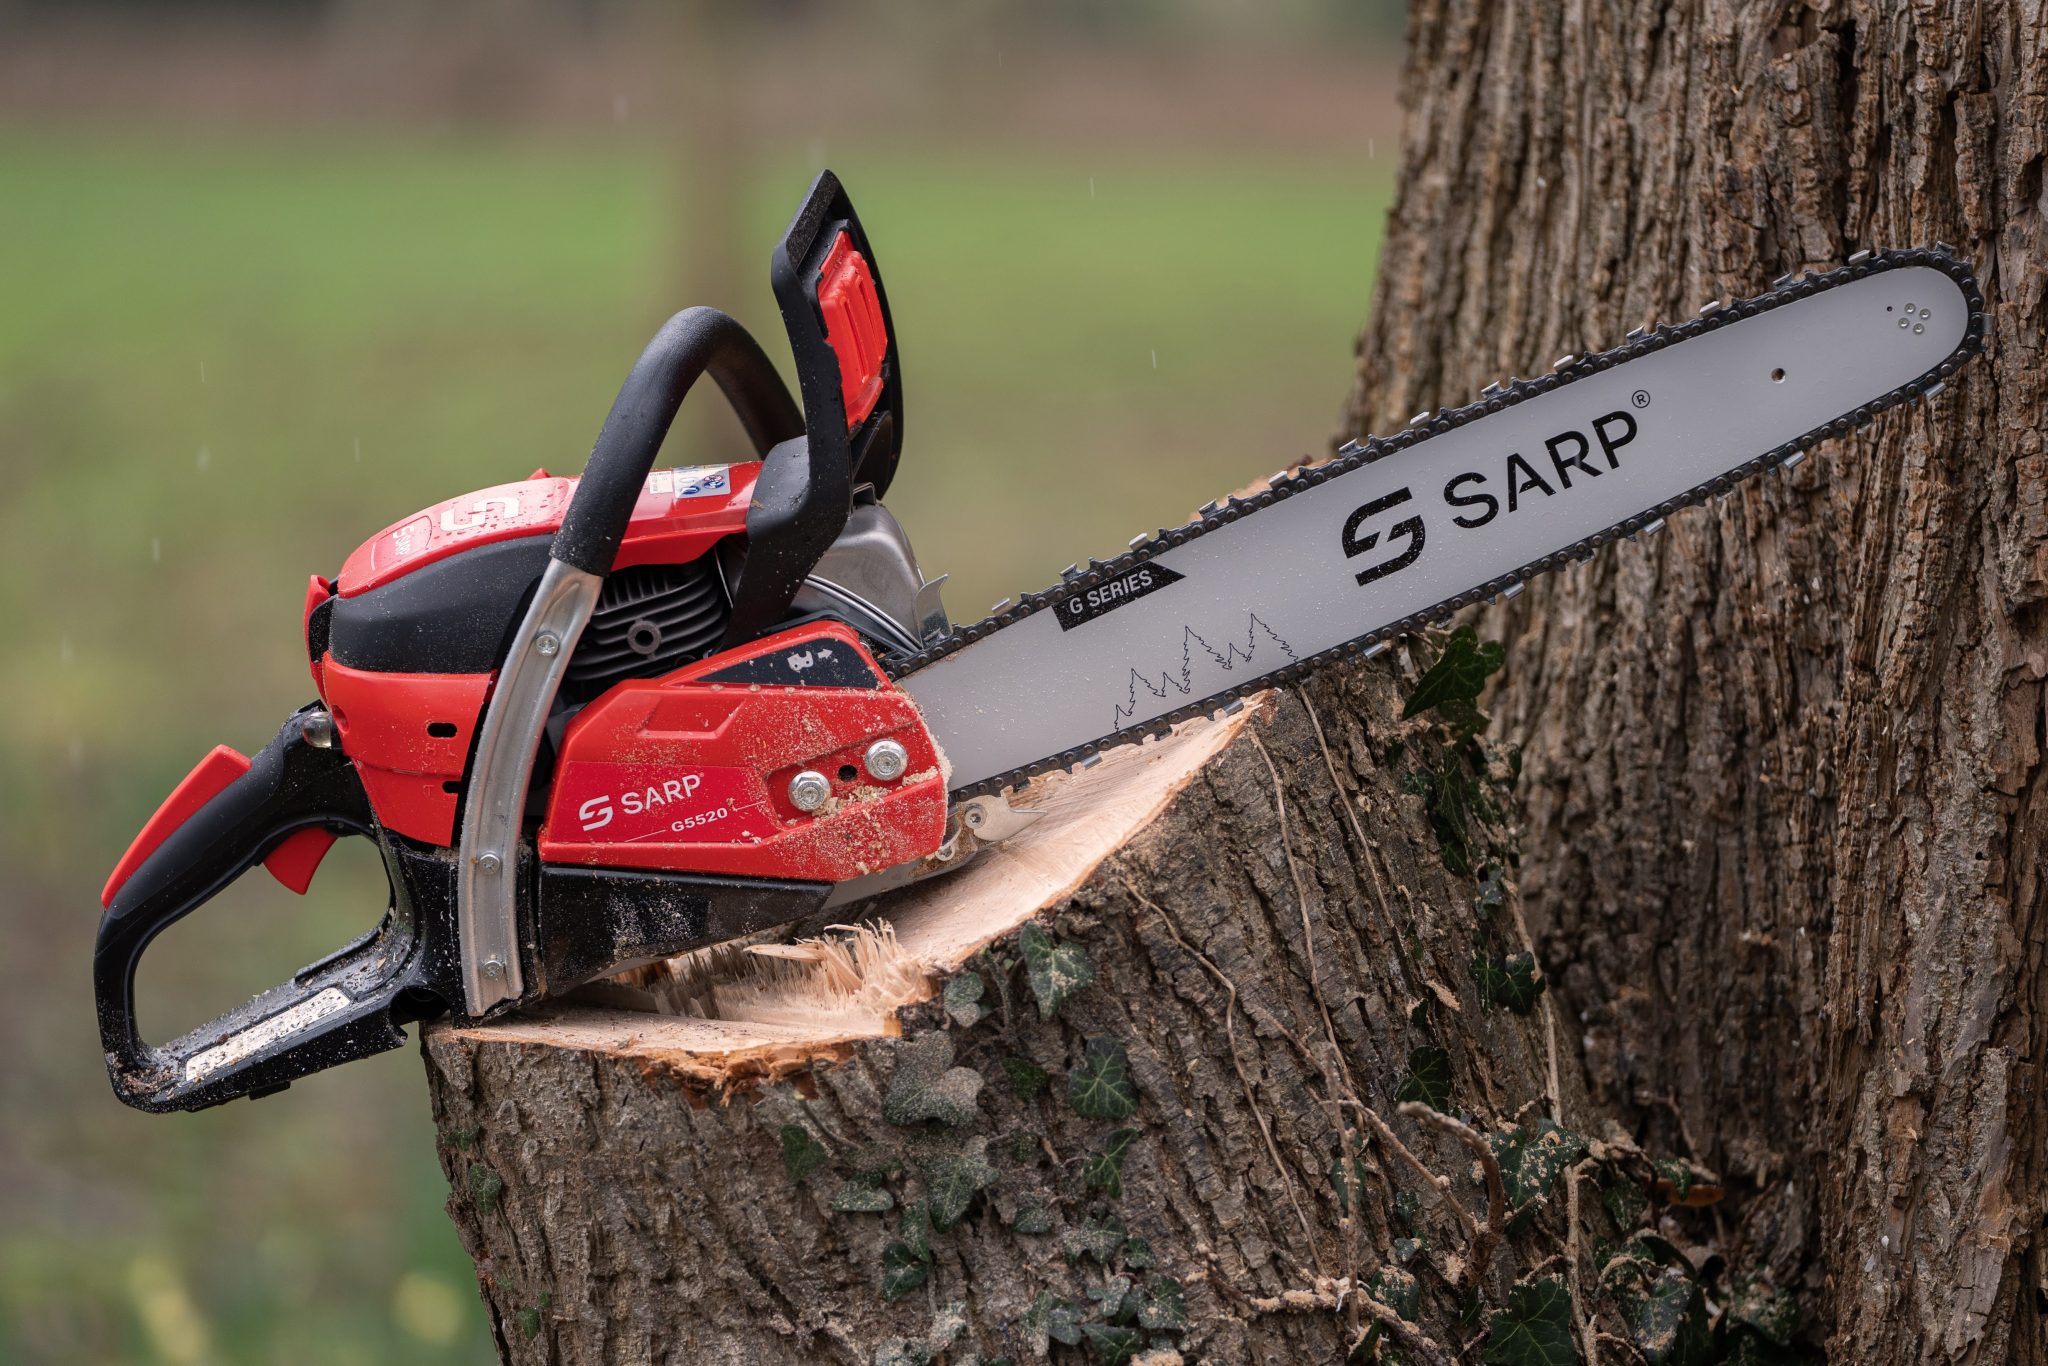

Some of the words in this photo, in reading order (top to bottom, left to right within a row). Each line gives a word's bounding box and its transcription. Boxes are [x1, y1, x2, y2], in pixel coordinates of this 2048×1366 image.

[1070, 597, 1083, 614] G
[1087, 570, 1153, 608] SERIES
[671, 807, 728, 832] G5520
